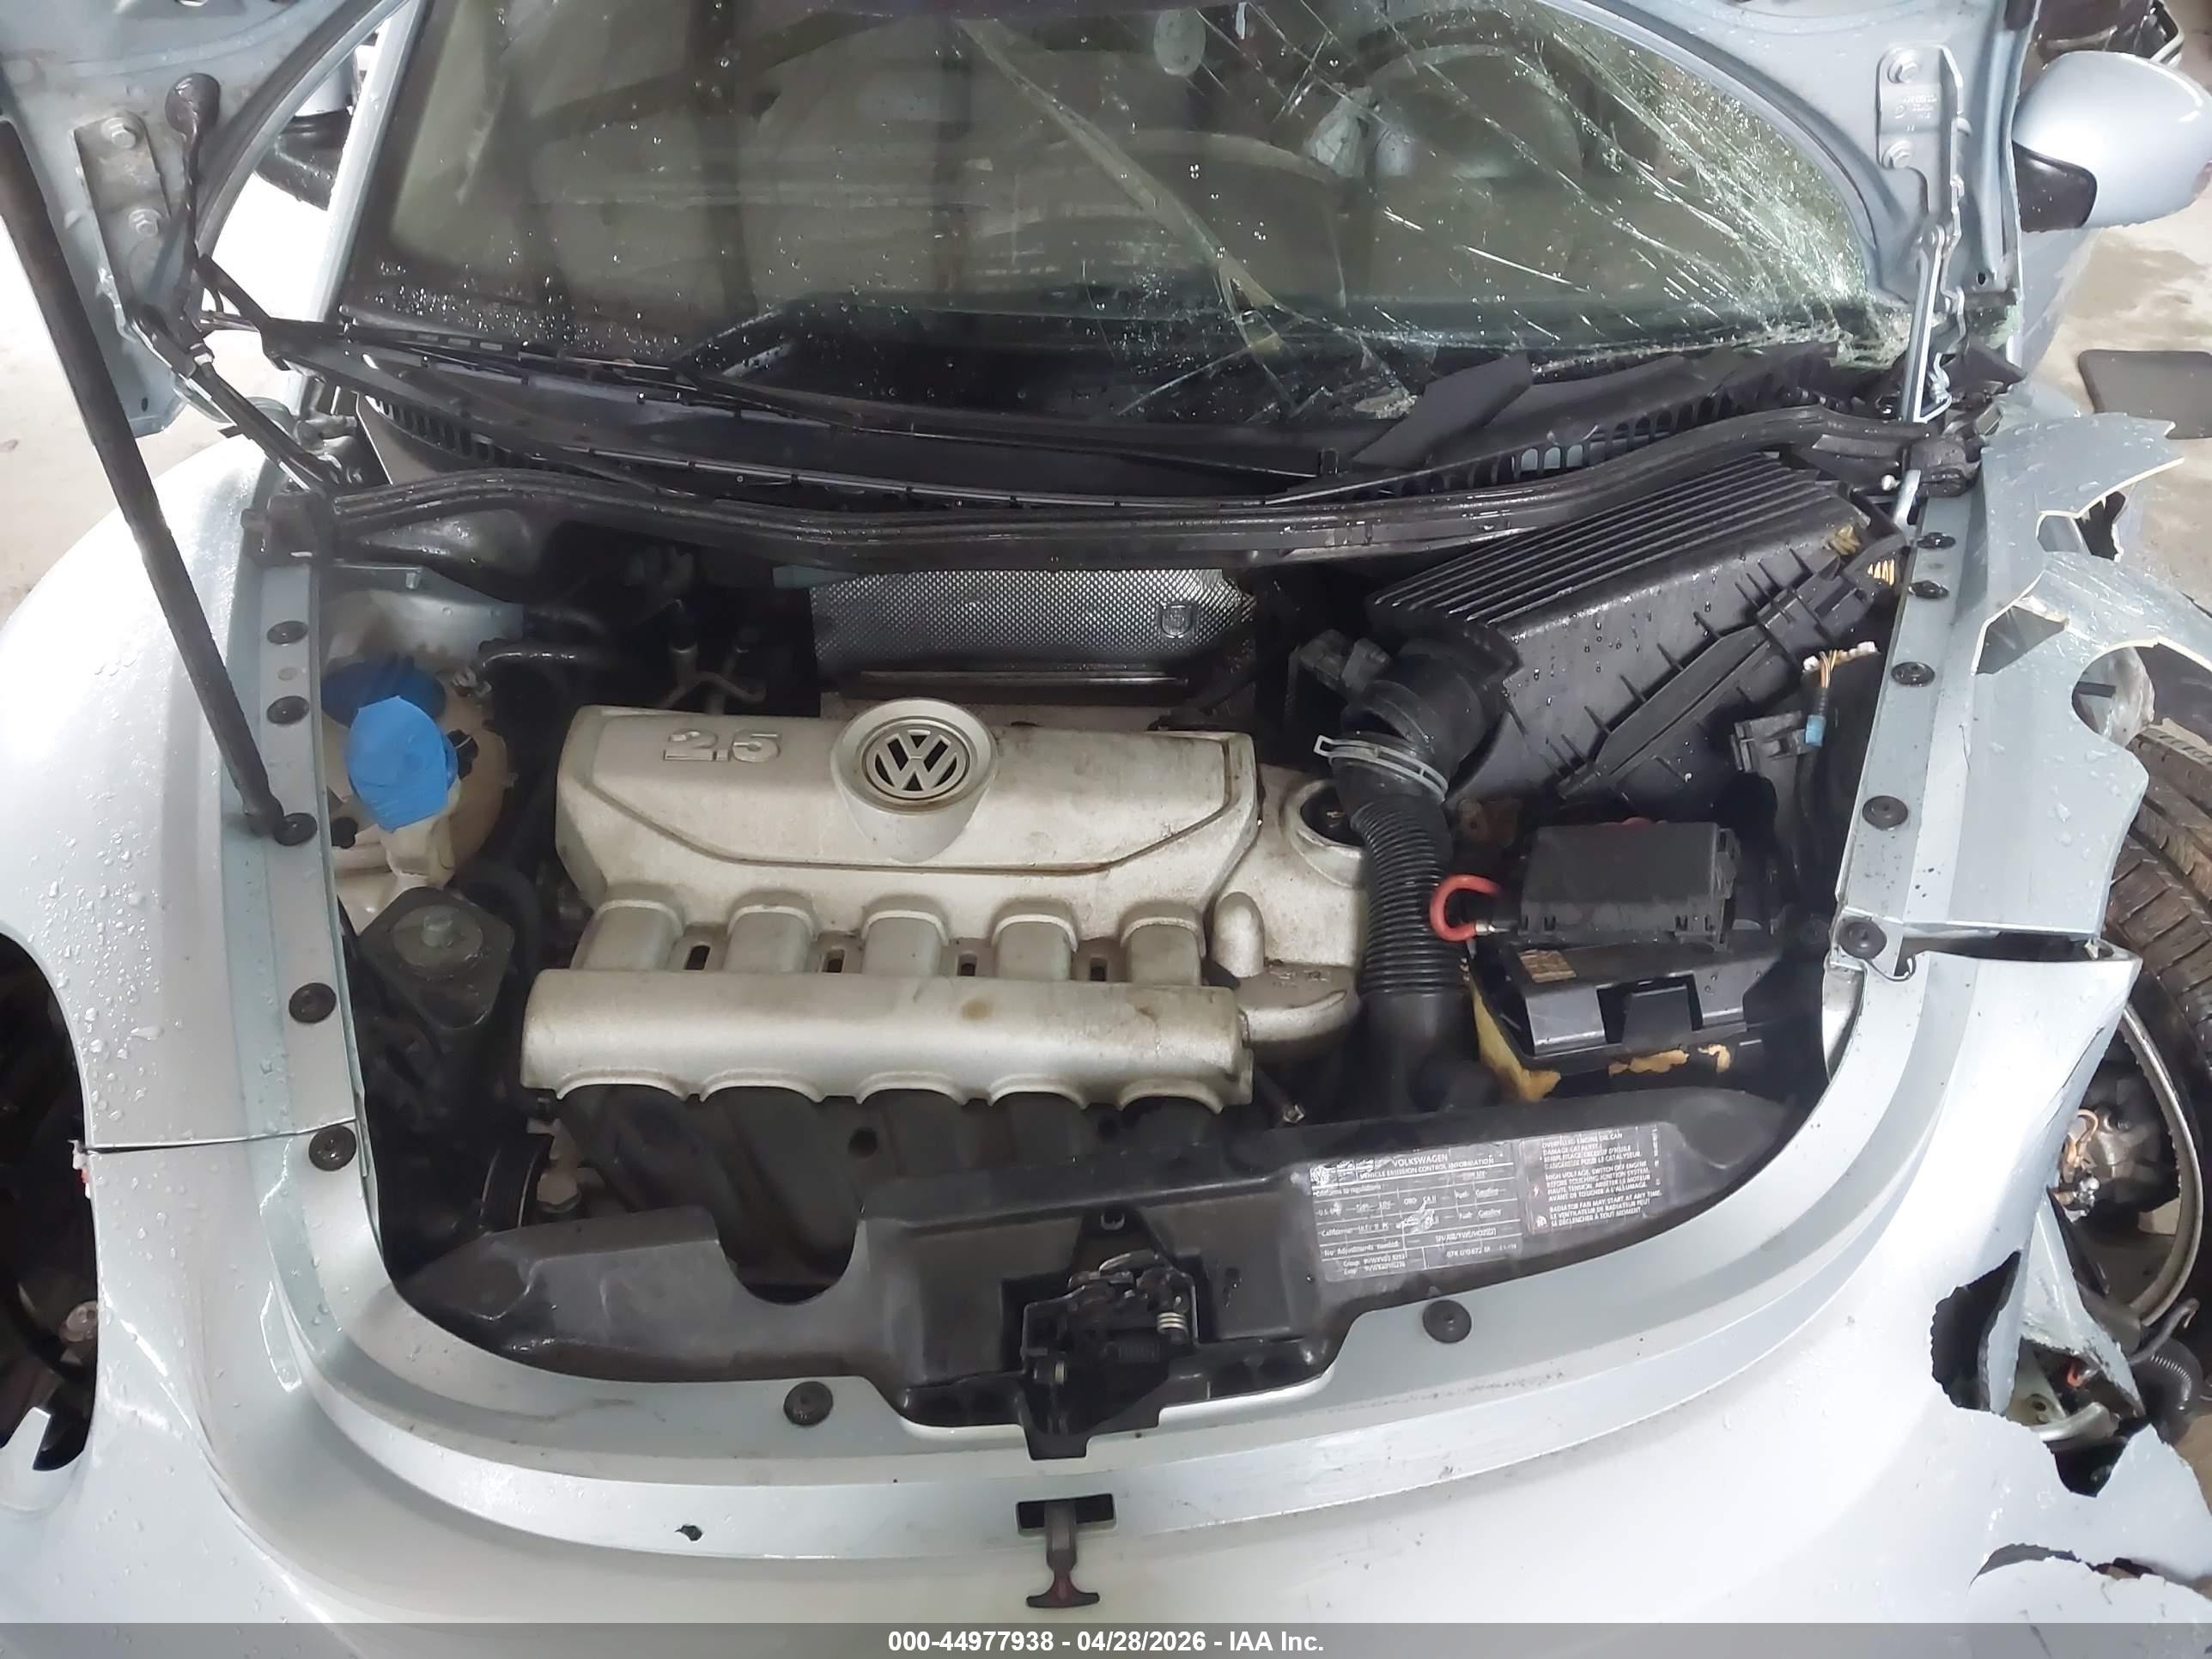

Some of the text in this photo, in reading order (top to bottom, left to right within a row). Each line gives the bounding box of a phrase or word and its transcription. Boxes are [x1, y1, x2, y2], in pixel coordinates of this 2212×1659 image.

[664, 727, 782, 763] 2.5
[1541, 1138, 1576, 1148] OVERFILLED
[1576, 1135, 1597, 1144] ENGINE
[1607, 1145, 1630, 1154] D'HUILE
[1543, 1146, 1568, 1156] DAMAGE
[1392, 1152, 1448, 1168] VOLKSWAGEN
[1359, 1170, 1385, 1180] VEHICLE
[1386, 1165, 1417, 1176] EMISSION
[1418, 1162, 1447, 1172] CONTROL
[1448, 1157, 1494, 1169] INFORMATION
[1545, 1172, 1560, 1181] HIGH
[1591, 1165, 1613, 1174] SWITCH
[1626, 1160, 1646, 1169] ENGINE
[1546, 1179, 1567, 1188] BEFORE
[1568, 1175, 1599, 1185] TOUCHING
[1600, 1170, 1626, 1180] IGNITION
[1547, 1186, 1565, 1194] HAUTE
[1626, 1174, 1650, 1182] MOTEUR
[1548, 1193, 1568, 1201] AVANT
[1578, 1188, 1603, 1197] TOUCHER
[1549, 1202, 1578, 1212] RADIATOR
[1607, 1195, 1625, 1204] START
[1558, 1206, 1595, 1218] VENTILATEUR
[1605, 1200, 1636, 1211] RADIATEUR
[1599, 1210, 1614, 1218] TOUT
[1336, 1243, 1373, 1255] Adjustments
